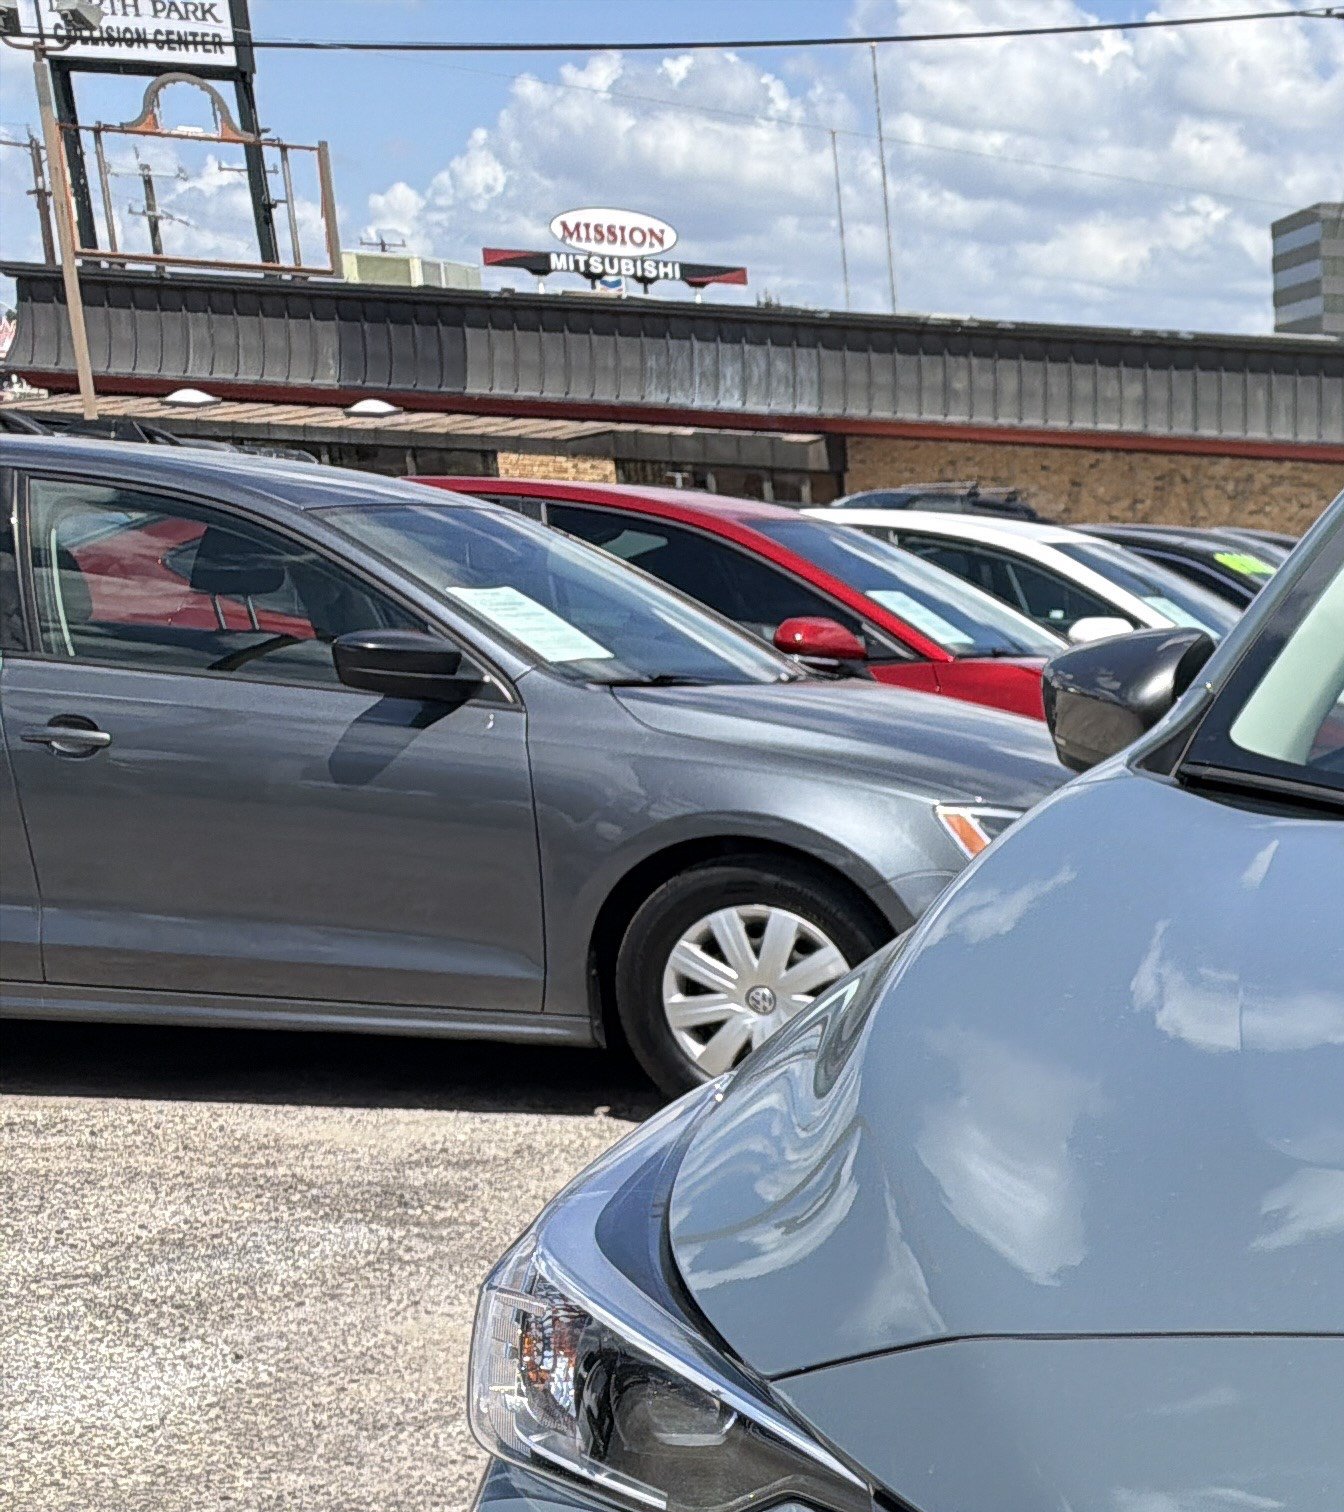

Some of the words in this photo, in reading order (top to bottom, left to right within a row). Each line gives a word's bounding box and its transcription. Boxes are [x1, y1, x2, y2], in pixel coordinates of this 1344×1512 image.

[151, 0, 223, 23] PARK
[153, 28, 224, 54] CENTER
[559, 220, 665, 248] MISSION
[550, 253, 681, 280] MITSUBISHI
